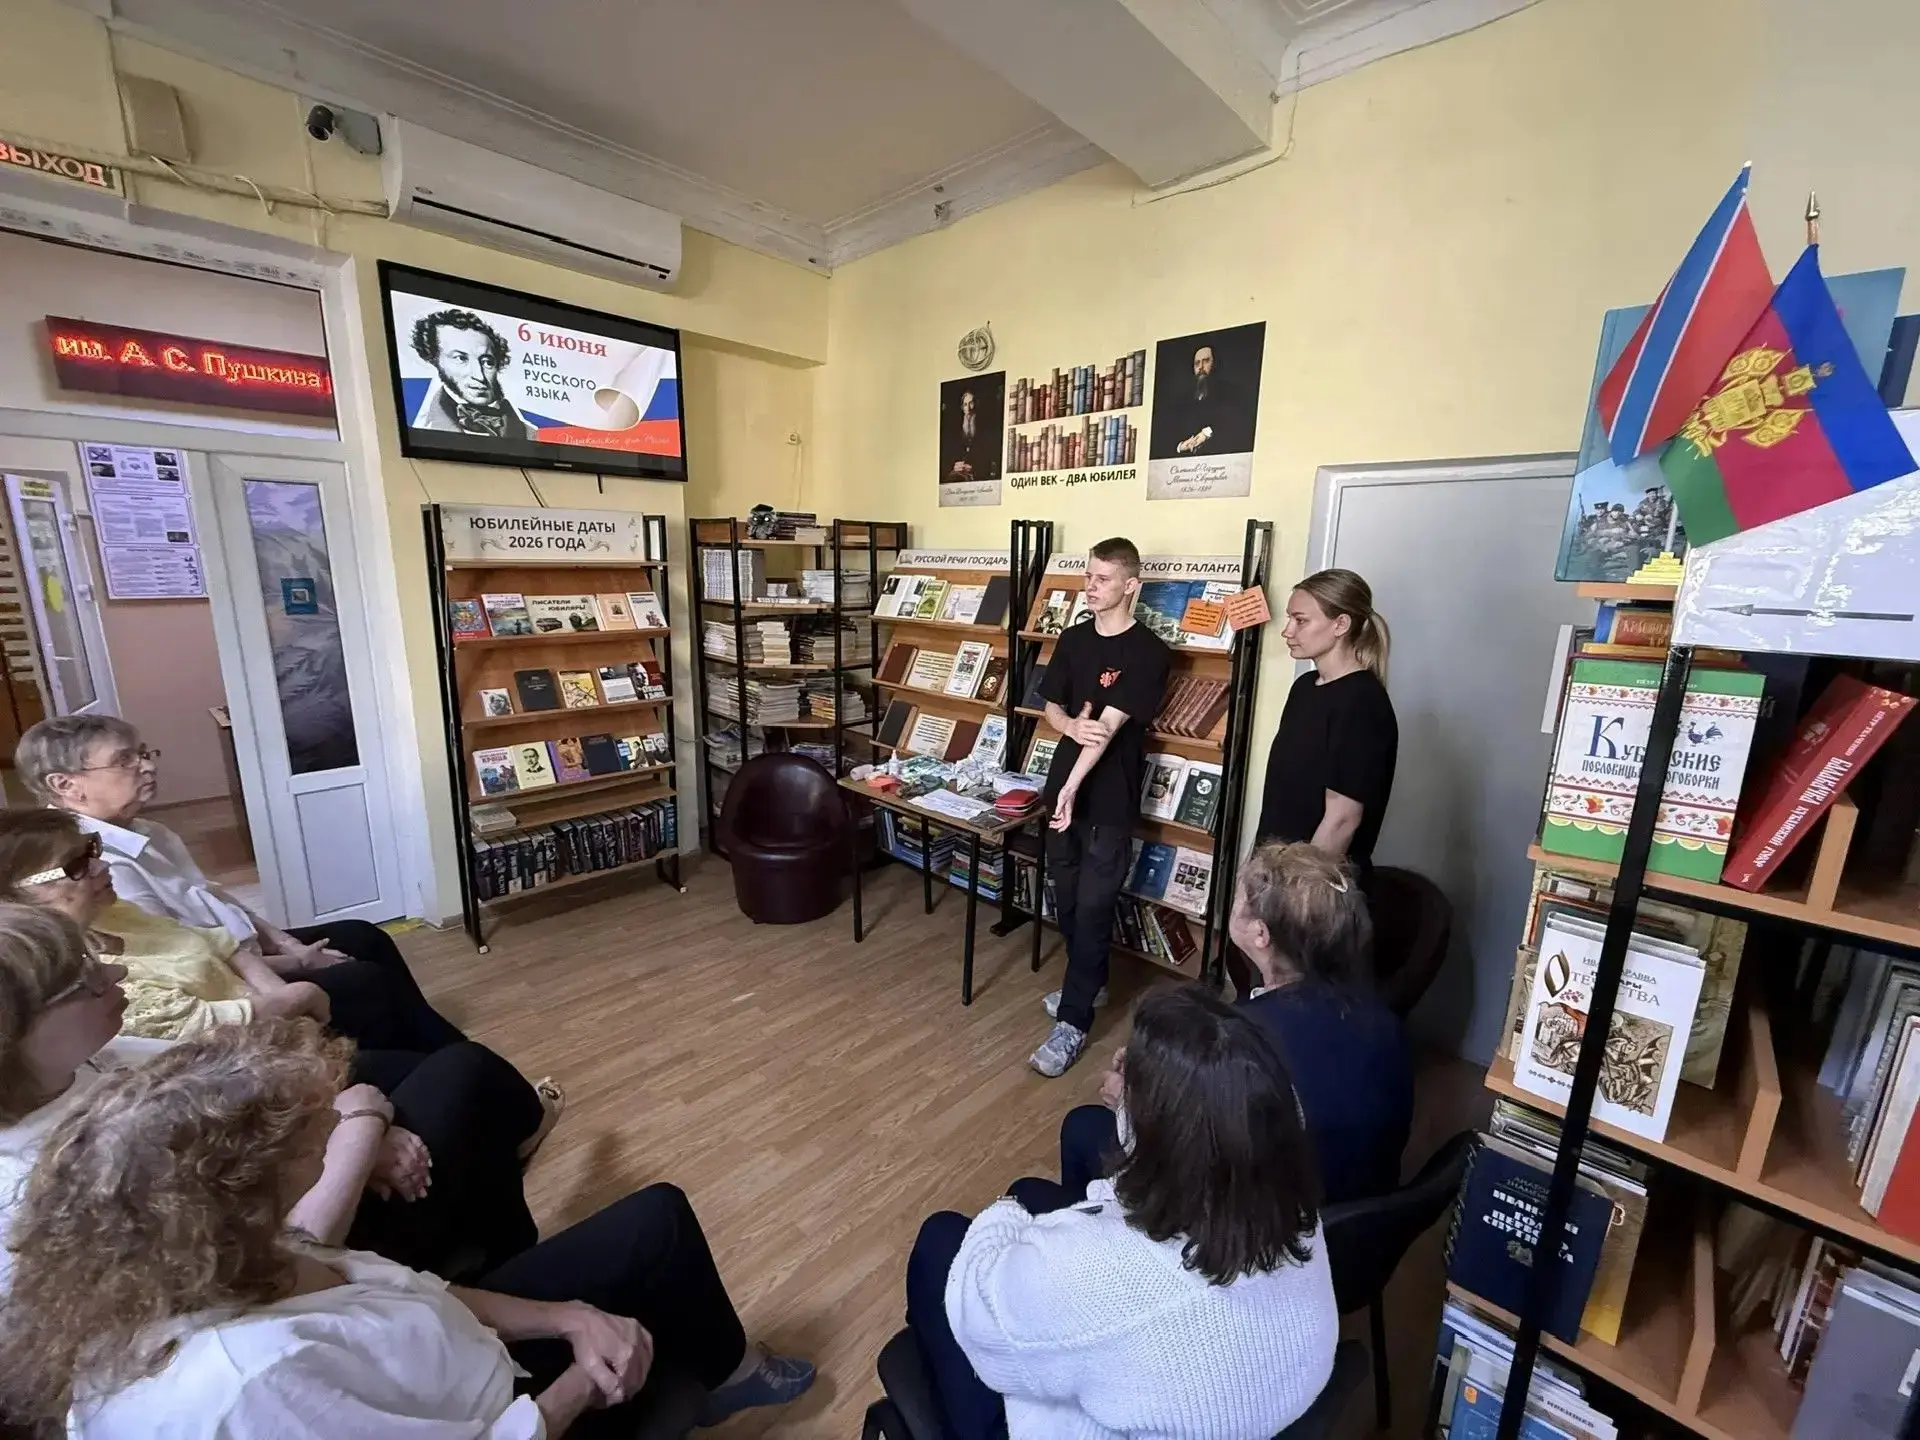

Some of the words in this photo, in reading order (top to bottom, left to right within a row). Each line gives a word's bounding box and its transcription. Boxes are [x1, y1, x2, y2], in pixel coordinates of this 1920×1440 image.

[517, 322, 531, 342] 6
[55, 334, 112, 361] им.
[119, 339, 156, 369] А.
[162, 346, 196, 373] С.
[202, 350, 322, 390] Пушкина
[522, 351, 557, 369] ДЕНЬ
[524, 368, 597, 391] РУССКОГО
[526, 385, 571, 402] ЯЗЫКА
[1010, 475, 1038, 489] ОДИН
[1041, 474, 1058, 486] ВЕК
[1066, 473, 1087, 487] ДВА
[1090, 469, 1136, 483] ЮБИЛЕЯ
[470, 516, 574, 532] ЮБИЛЕЙНЫЕ
[577, 521, 616, 534] ДАТЫ
[508, 536, 543, 548] 2026
[547, 537, 586, 551] ГОДА
[914, 554, 947, 564] РУССКОЙ
[948, 556, 967, 564] РЕЧИ
[968, 556, 1008, 565] ГОСУДАРЬ
[1058, 559, 1086, 570] СИЛА
[1139, 561, 1183, 572] ЕСКОГО
[1185, 561, 1241, 574] ТАЛАНТА
[547, 604, 586, 612] ЮБИЛЯРЫ
[1583, 714, 1722, 773] КУБСКИЕ
[1666, 770, 1721, 790] ОГОВОРКИ
[1544, 949, 1660, 1006] ОТЕТВА
[1622, 968, 1657, 985] РАВВА
